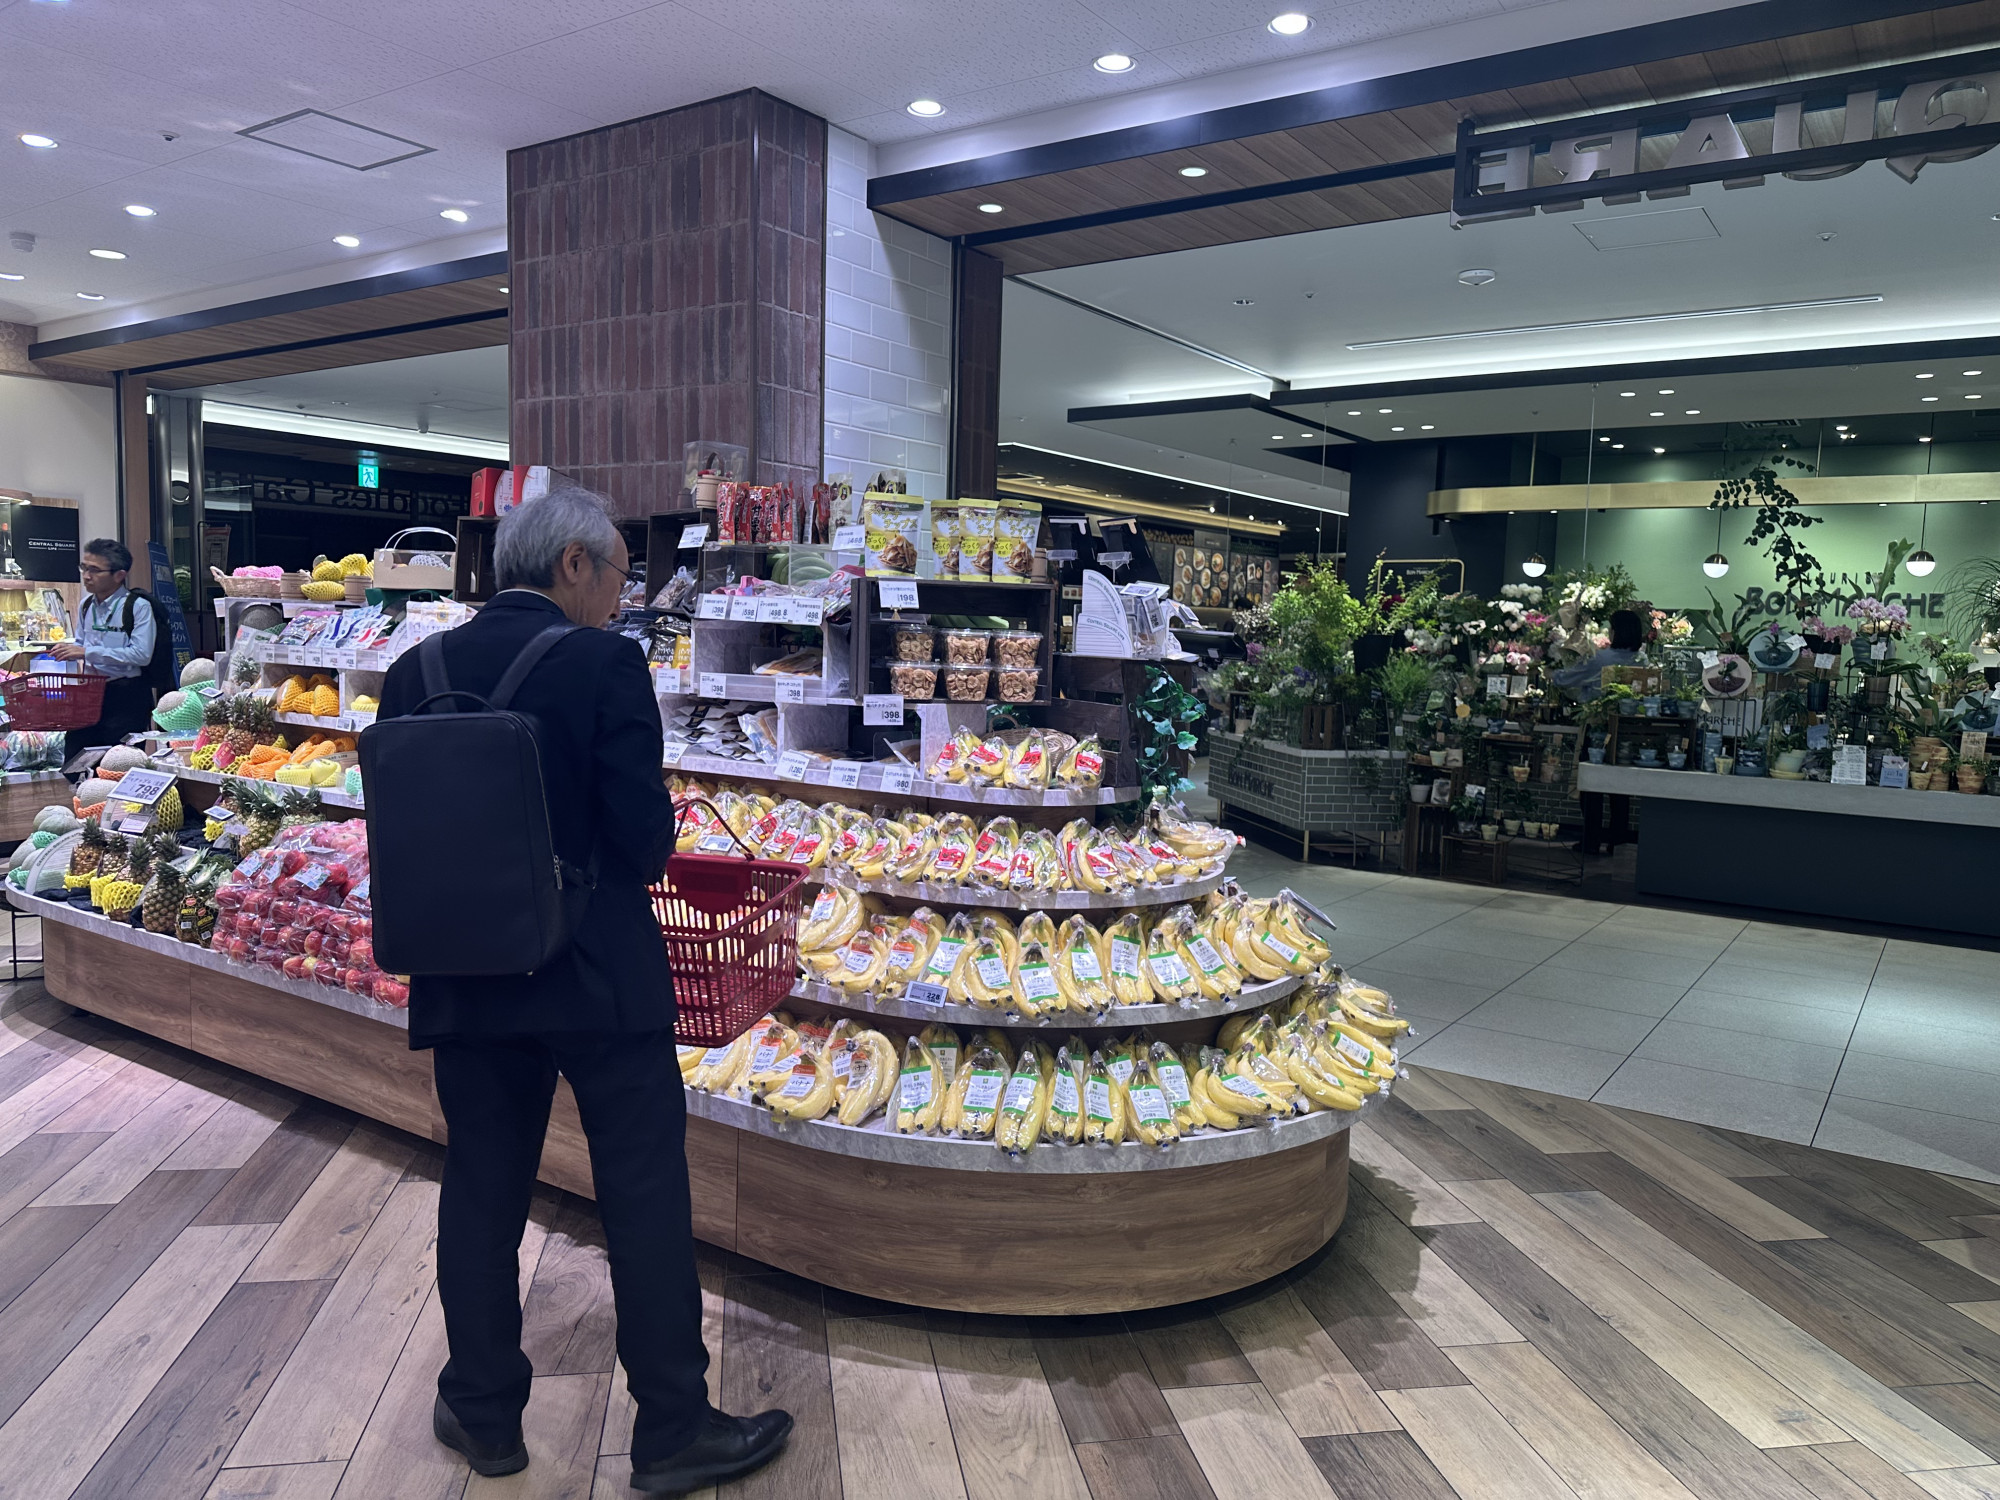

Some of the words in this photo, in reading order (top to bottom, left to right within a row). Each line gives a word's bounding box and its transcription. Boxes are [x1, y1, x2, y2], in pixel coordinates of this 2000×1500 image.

[884, 518, 918, 529] チップス
[135, 784, 160, 795] 798
